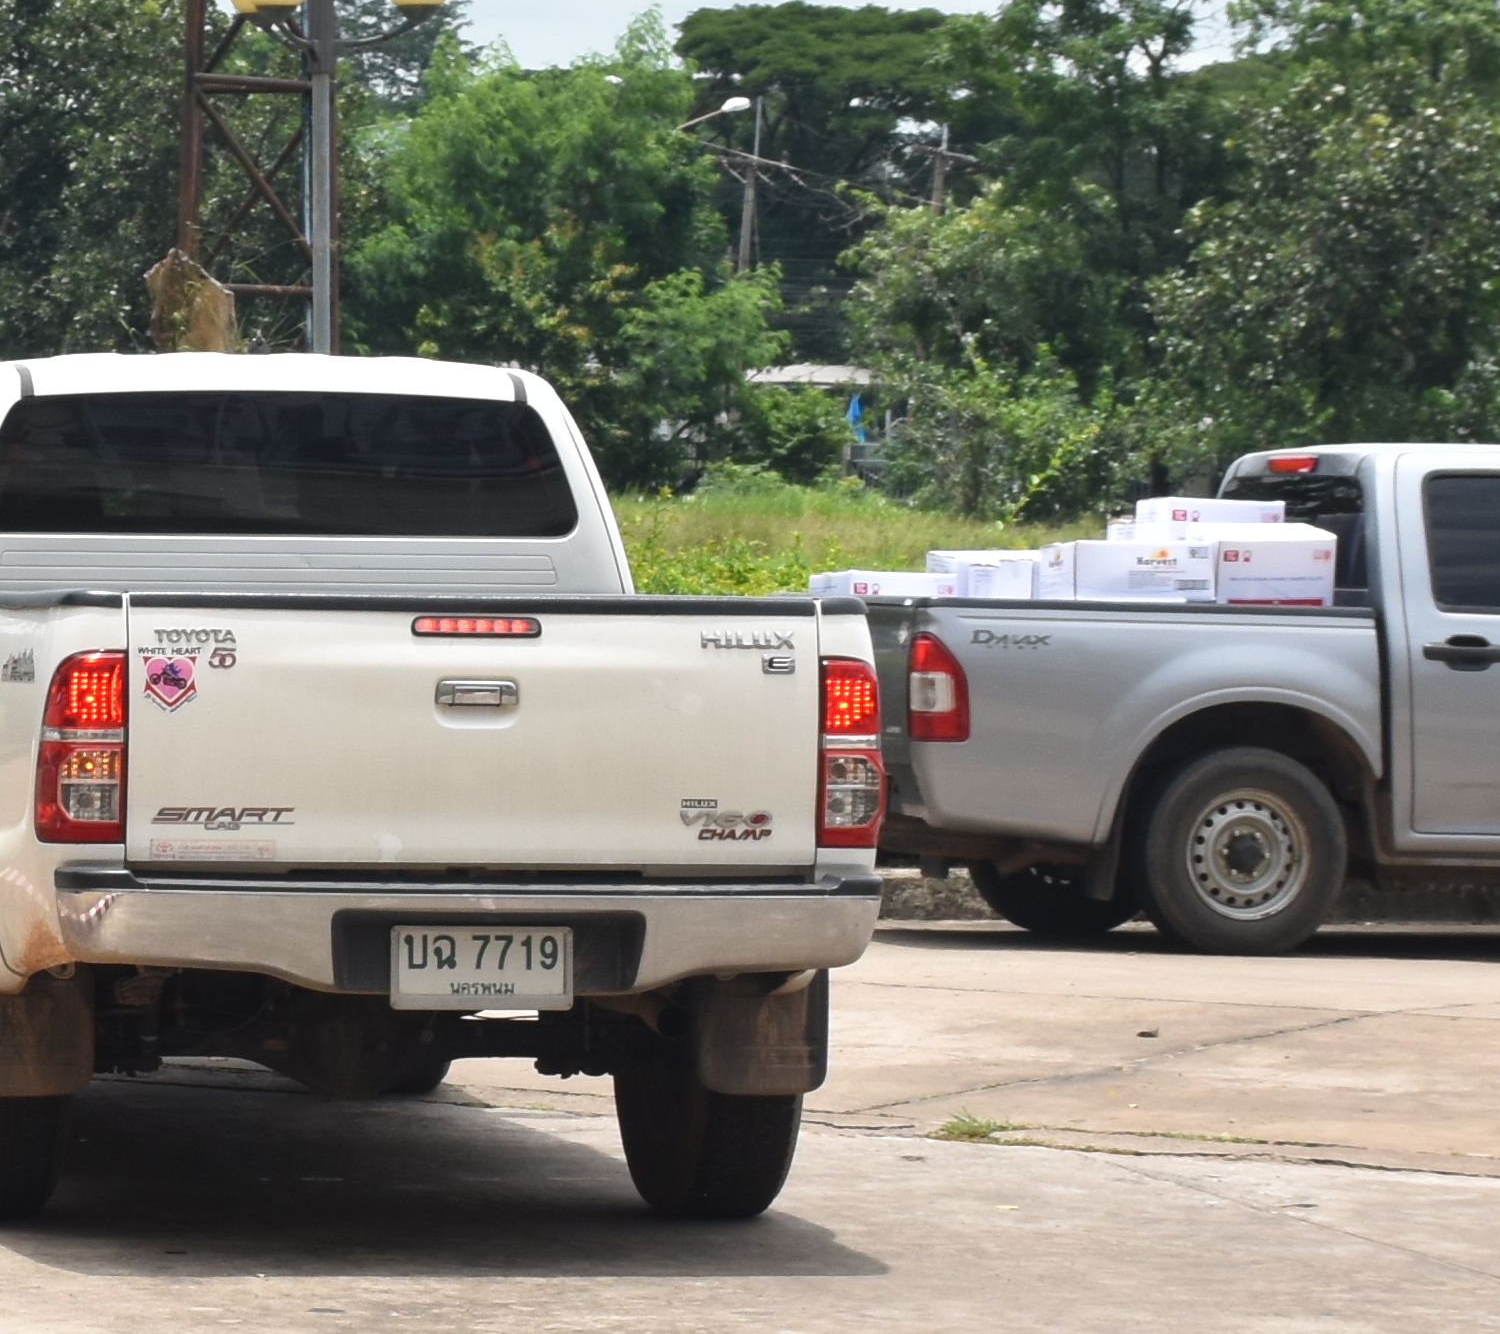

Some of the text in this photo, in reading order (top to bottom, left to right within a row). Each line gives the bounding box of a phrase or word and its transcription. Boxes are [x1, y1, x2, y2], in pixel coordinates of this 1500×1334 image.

[154, 629, 237, 644] TOYOTA
[700, 629, 795, 649] HILUX
[138, 647, 202, 655] WHITE HEART
[681, 799, 718, 809] HILUX
[151, 807, 295, 823] SMART
[680, 810, 773, 828] VIGO
[204, 821, 241, 831] CAB
[698, 828, 772, 840] CHAMP
[404, 934, 559, 971] บฉ 7719
[450, 982, 515, 995] นครพนม
